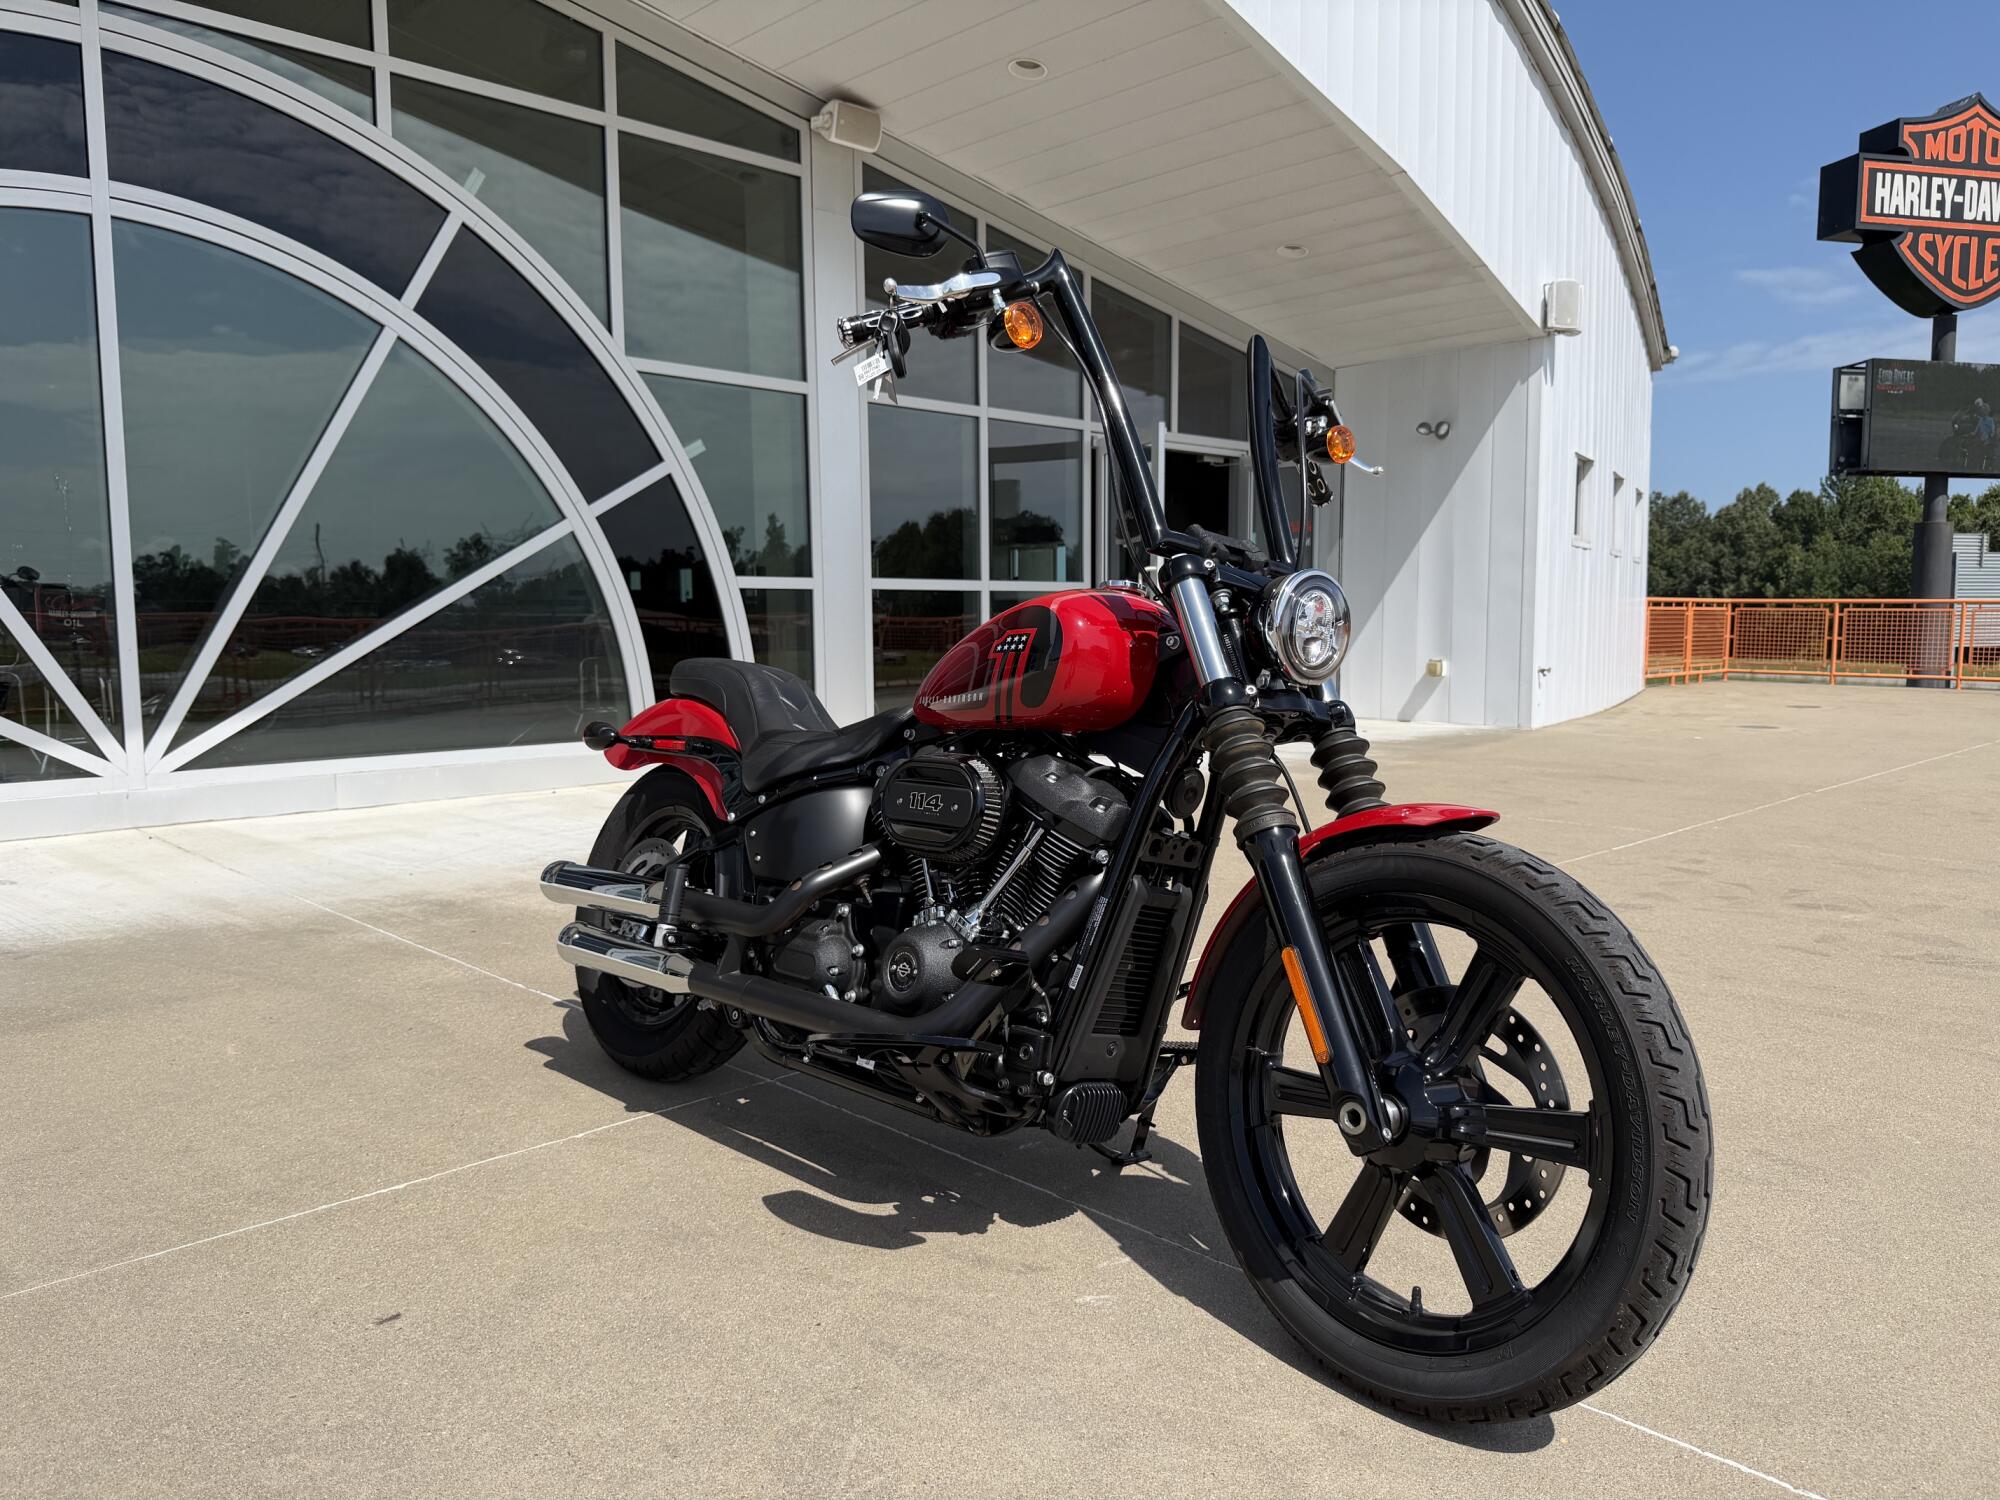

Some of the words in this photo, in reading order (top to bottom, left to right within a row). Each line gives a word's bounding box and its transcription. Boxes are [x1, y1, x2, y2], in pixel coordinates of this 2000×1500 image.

[64, 618, 84, 627] OIL
[909, 791, 944, 812] 114
[1565, 955, 1645, 1224] HARLEY-DAVIDSON
